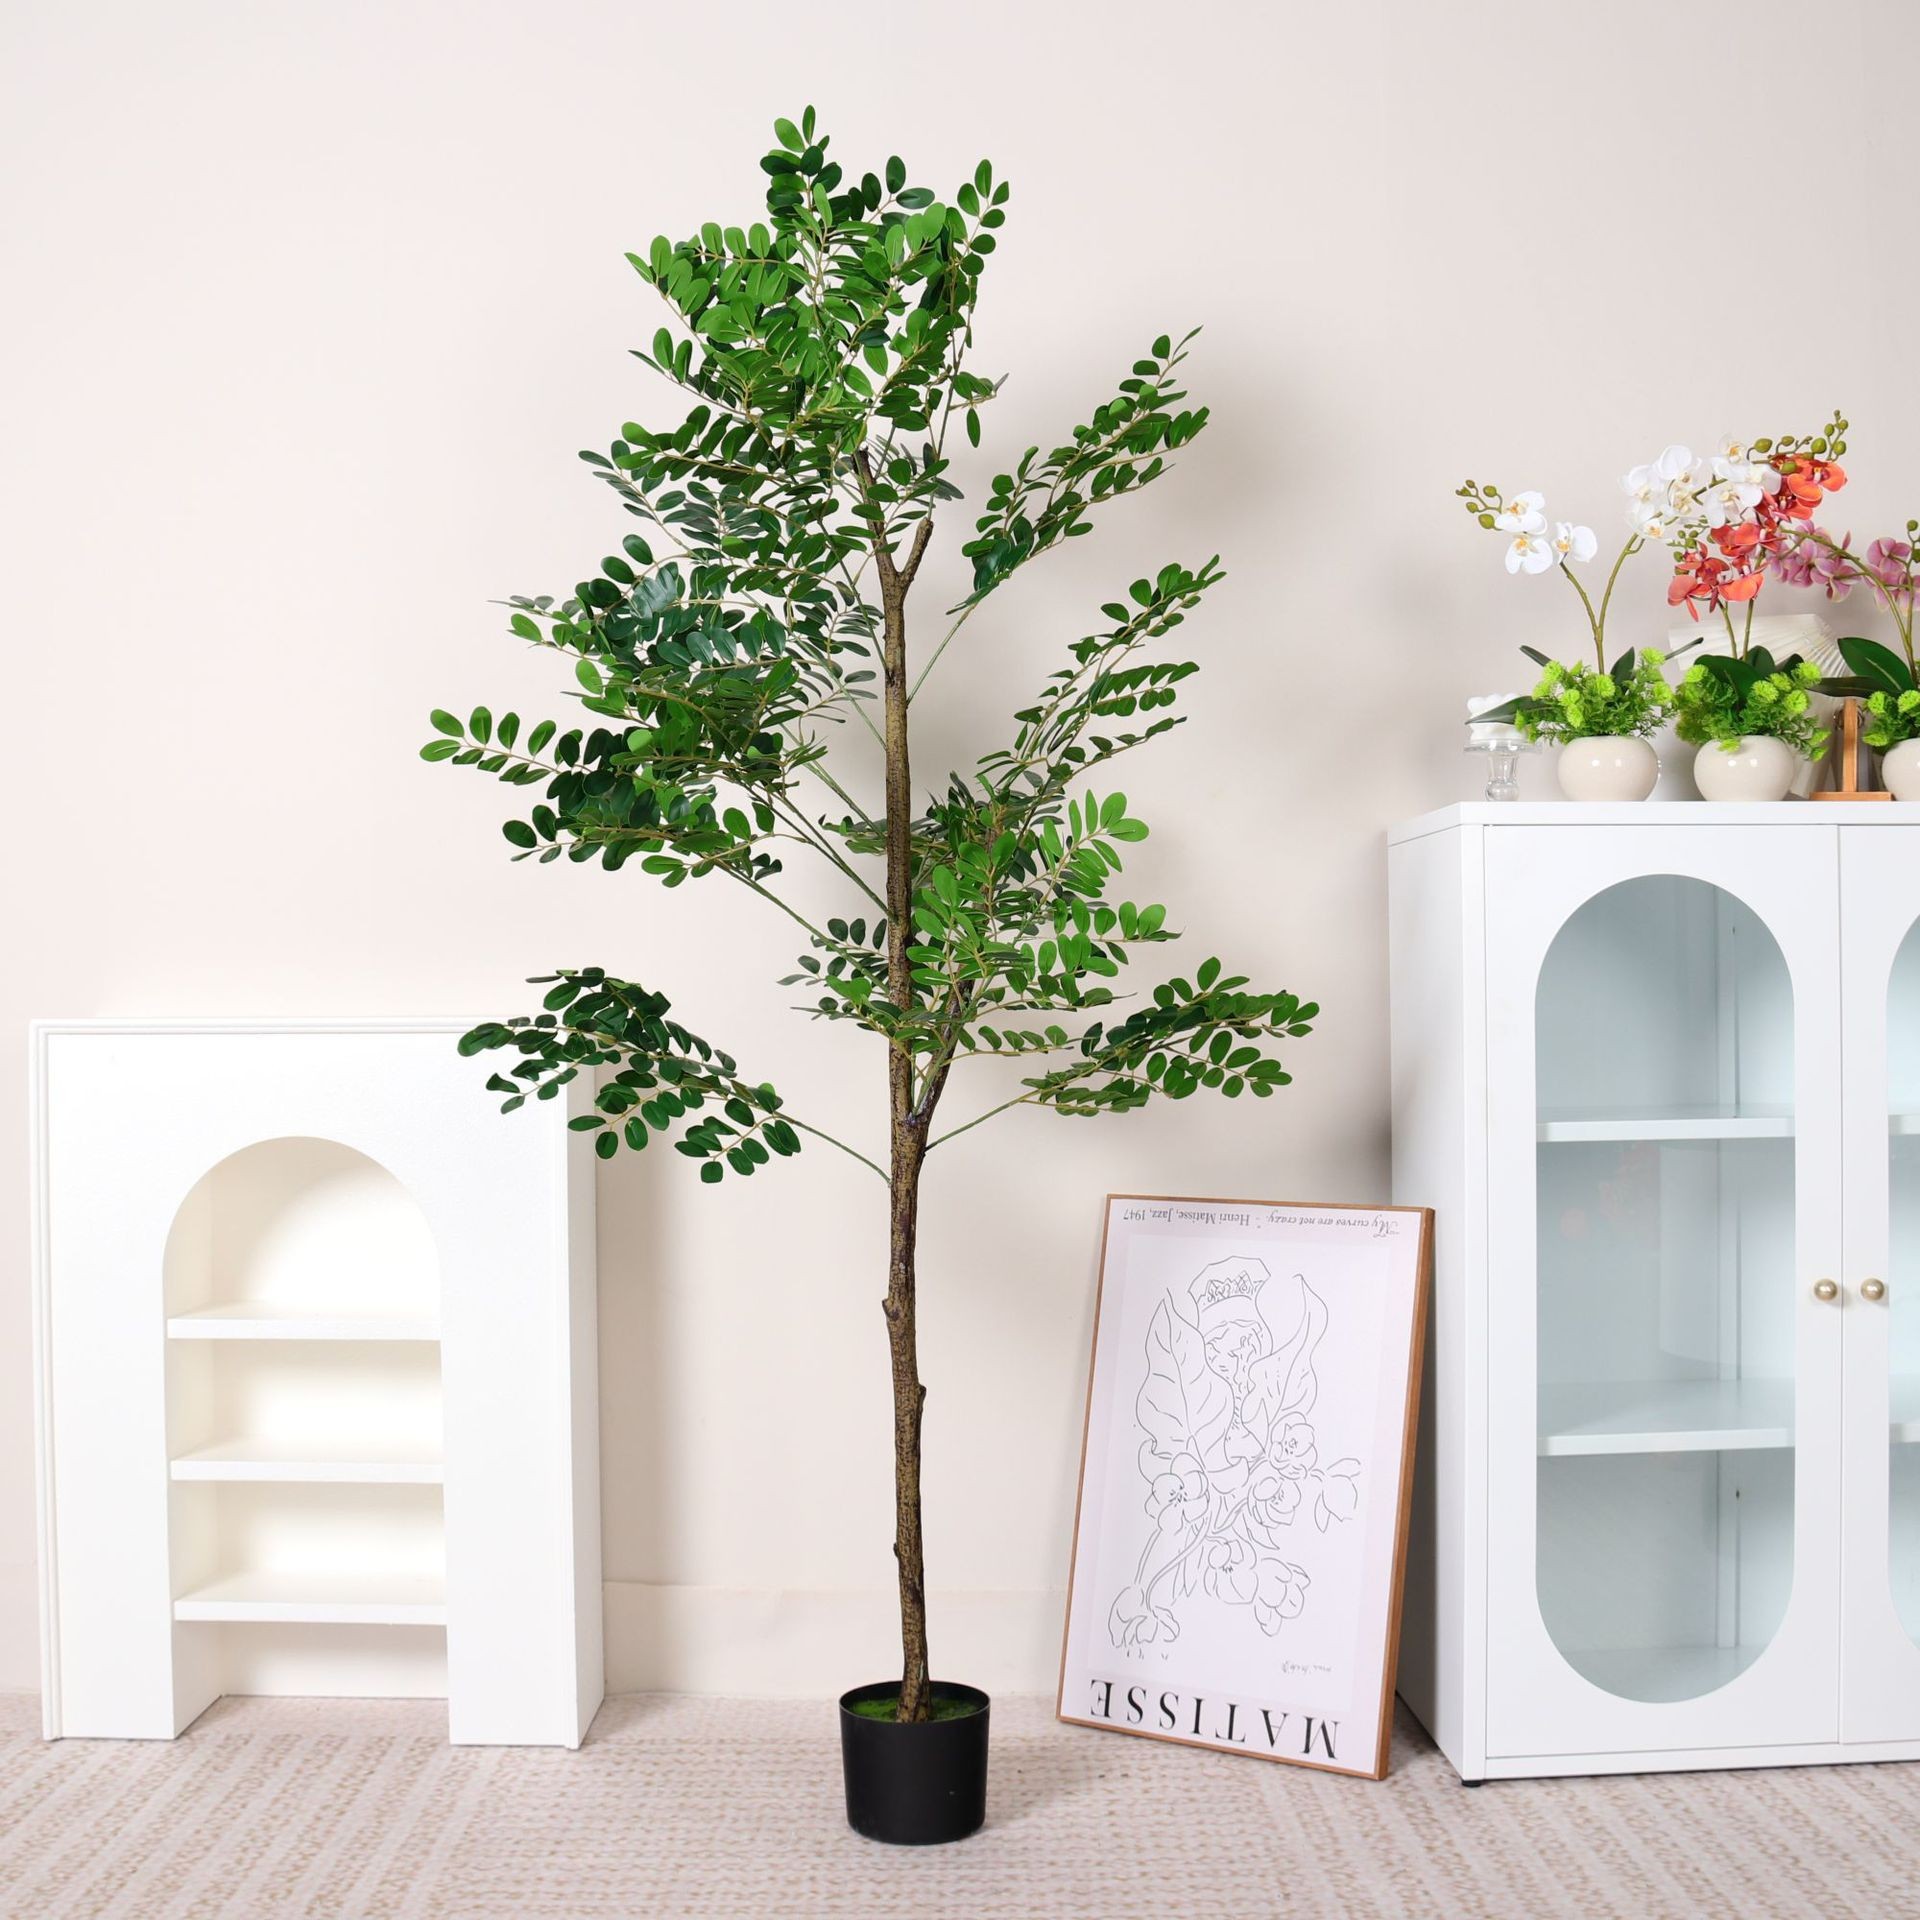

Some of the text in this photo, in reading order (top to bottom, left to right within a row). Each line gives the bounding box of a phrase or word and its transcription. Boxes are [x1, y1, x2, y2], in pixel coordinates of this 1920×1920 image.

[1123, 1208, 1146, 1221] 1947
[1149, 1208, 1174, 1223] Jazz,
[1176, 1209, 1217, 1225] Matisse,
[1219, 1213, 1251, 1227] Henri
[1299, 1215, 1316, 1225] not
[1317, 1215, 1334, 1225] are
[1335, 1216, 1370, 1228] curves
[1372, 1214, 1400, 1238] My
[1090, 1679, 1341, 1760] MATISSE
